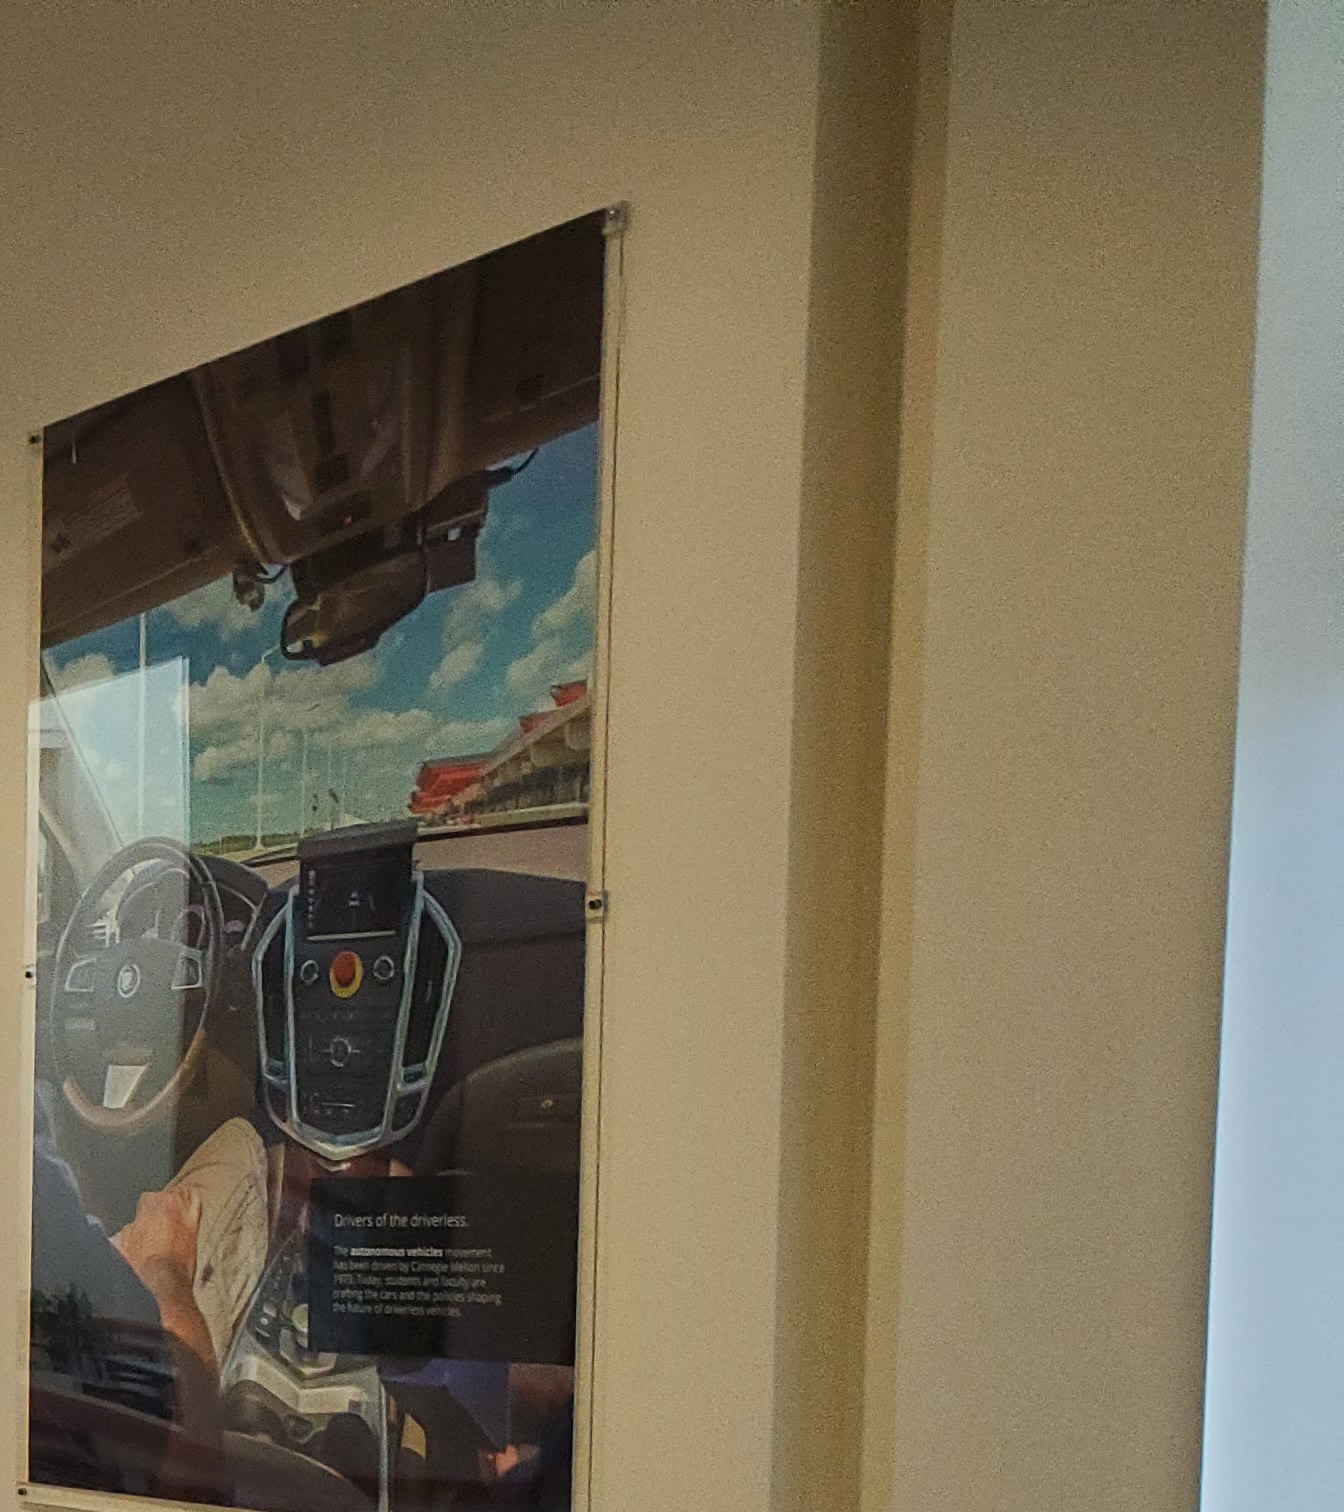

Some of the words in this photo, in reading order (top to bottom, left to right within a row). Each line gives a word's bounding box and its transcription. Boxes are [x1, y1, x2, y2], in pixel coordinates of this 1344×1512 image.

[334, 1212, 373, 1227] Drivers
[375, 1212, 388, 1227] of
[390, 1213, 408, 1227] the
[410, 1213, 469, 1227] driverless.
[334, 1246, 348, 1257] The
[349, 1247, 405, 1257] autonomous
[406, 1246, 443, 1257] vehicles
[445, 1248, 492, 1258] movement
[349, 1261, 369, 1271] been
[370, 1261, 397, 1271] driven
[398, 1262, 409, 1274] by
[411, 1261, 449, 1275] Carnegie
[450, 1261, 480, 1273] Mellon
[481, 1262, 506, 1273] since
[383, 1275, 421, 1286] students
[422, 1275, 439, 1287] and
[440, 1275, 469, 1290] faculty
[471, 1278, 487, 1288] are
[364, 1289, 378, 1300] the
[379, 1291, 397, 1301] cars
[398, 1291, 415, 1301] and
[416, 1291, 431, 1301] the
[432, 1292, 465, 1303] policies
[466, 1292, 502, 1307] shaping
[332, 1302, 346, 1312] the
[347, 1303, 372, 1313] future
[373, 1303, 383, 1314] of
[384, 1304, 425, 1315] driverless
